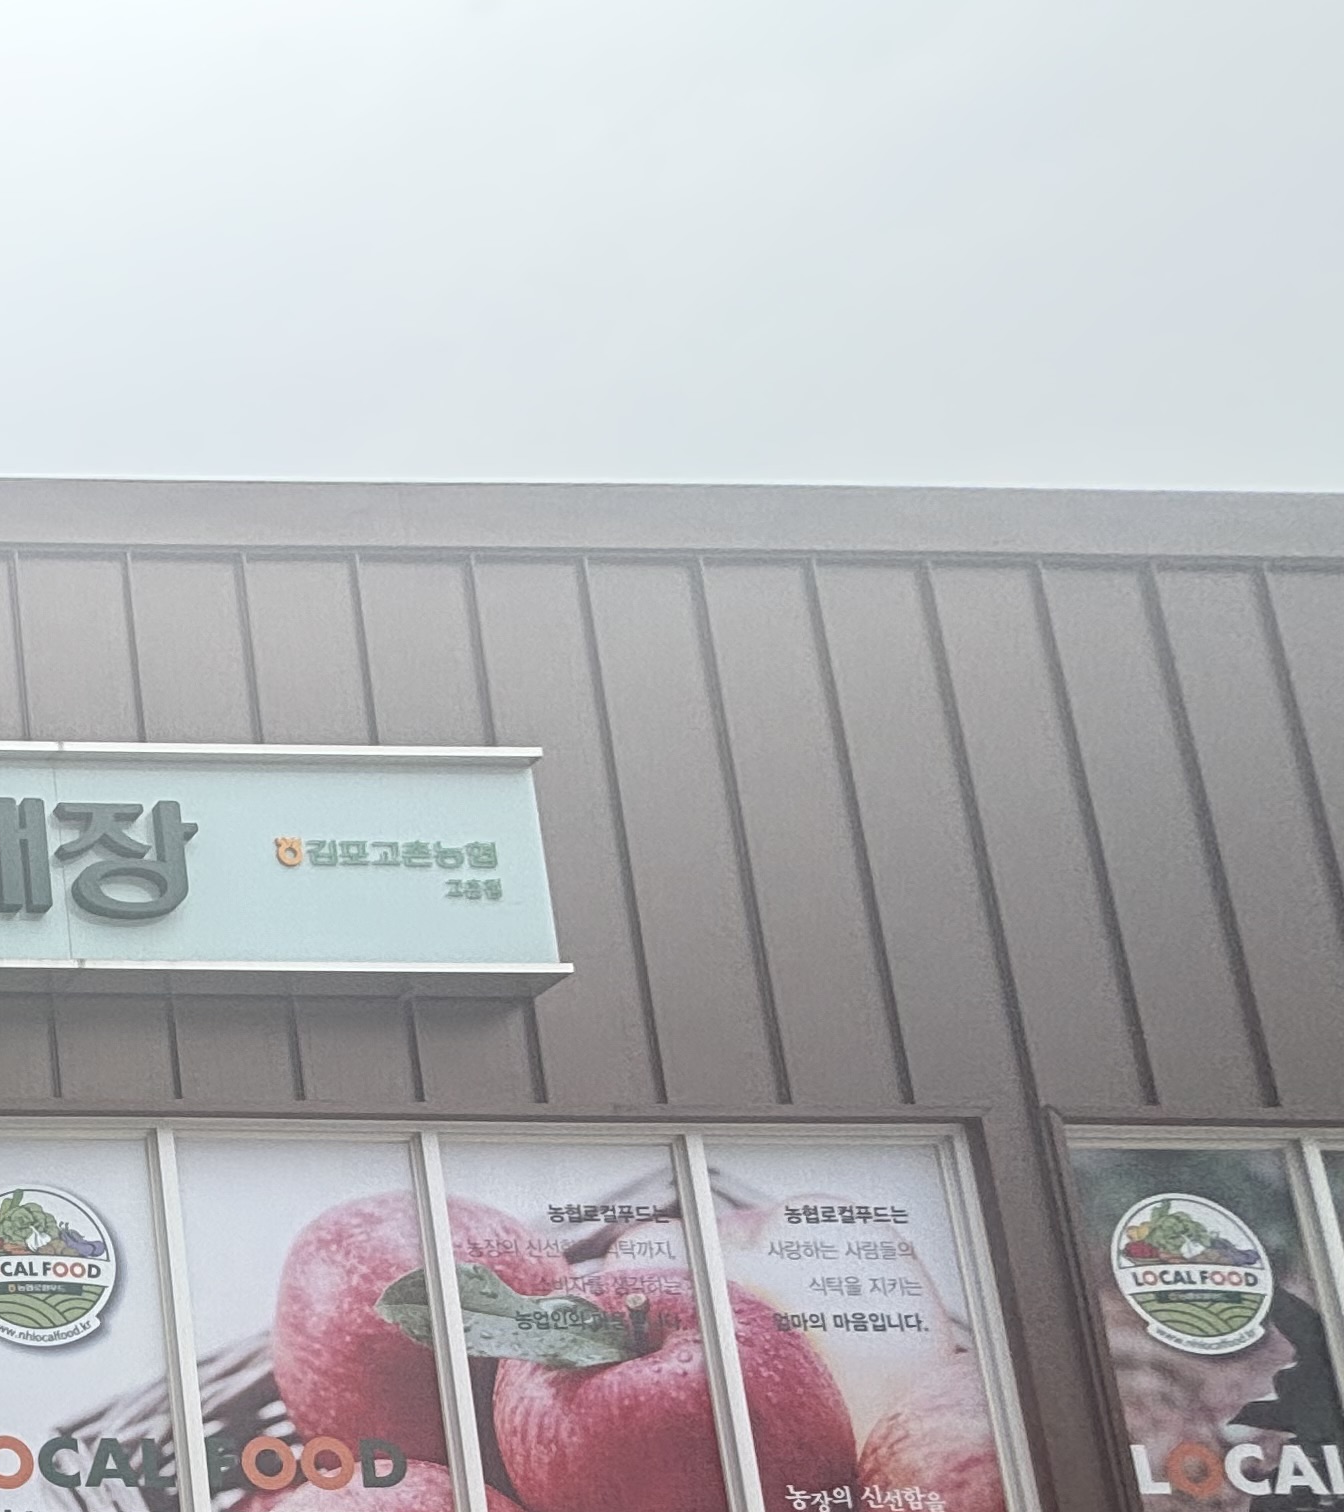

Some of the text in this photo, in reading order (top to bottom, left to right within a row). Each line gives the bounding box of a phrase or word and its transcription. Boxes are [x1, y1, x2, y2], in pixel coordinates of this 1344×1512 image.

[306, 839, 499, 869] 김포고촌농협
[548, 1204, 671, 1224] 농협로컬푸드는
[784, 1205, 909, 1225] 농협로컬푸드는
[768, 1241, 915, 1261] 사랑하는 사람들의
[42, 1261, 102, 1279] FOOD
[1132, 1270, 1259, 1288] LOCAL FOOD
[809, 1276, 923, 1297] 식탁을 지키는
[514, 1311, 586, 1331] 농업인의
[774, 1312, 930, 1332] 엄마의 마음입니다.
[205, 1436, 408, 1490] FOOD
[1130, 1442, 1344, 1497] LOCAL
